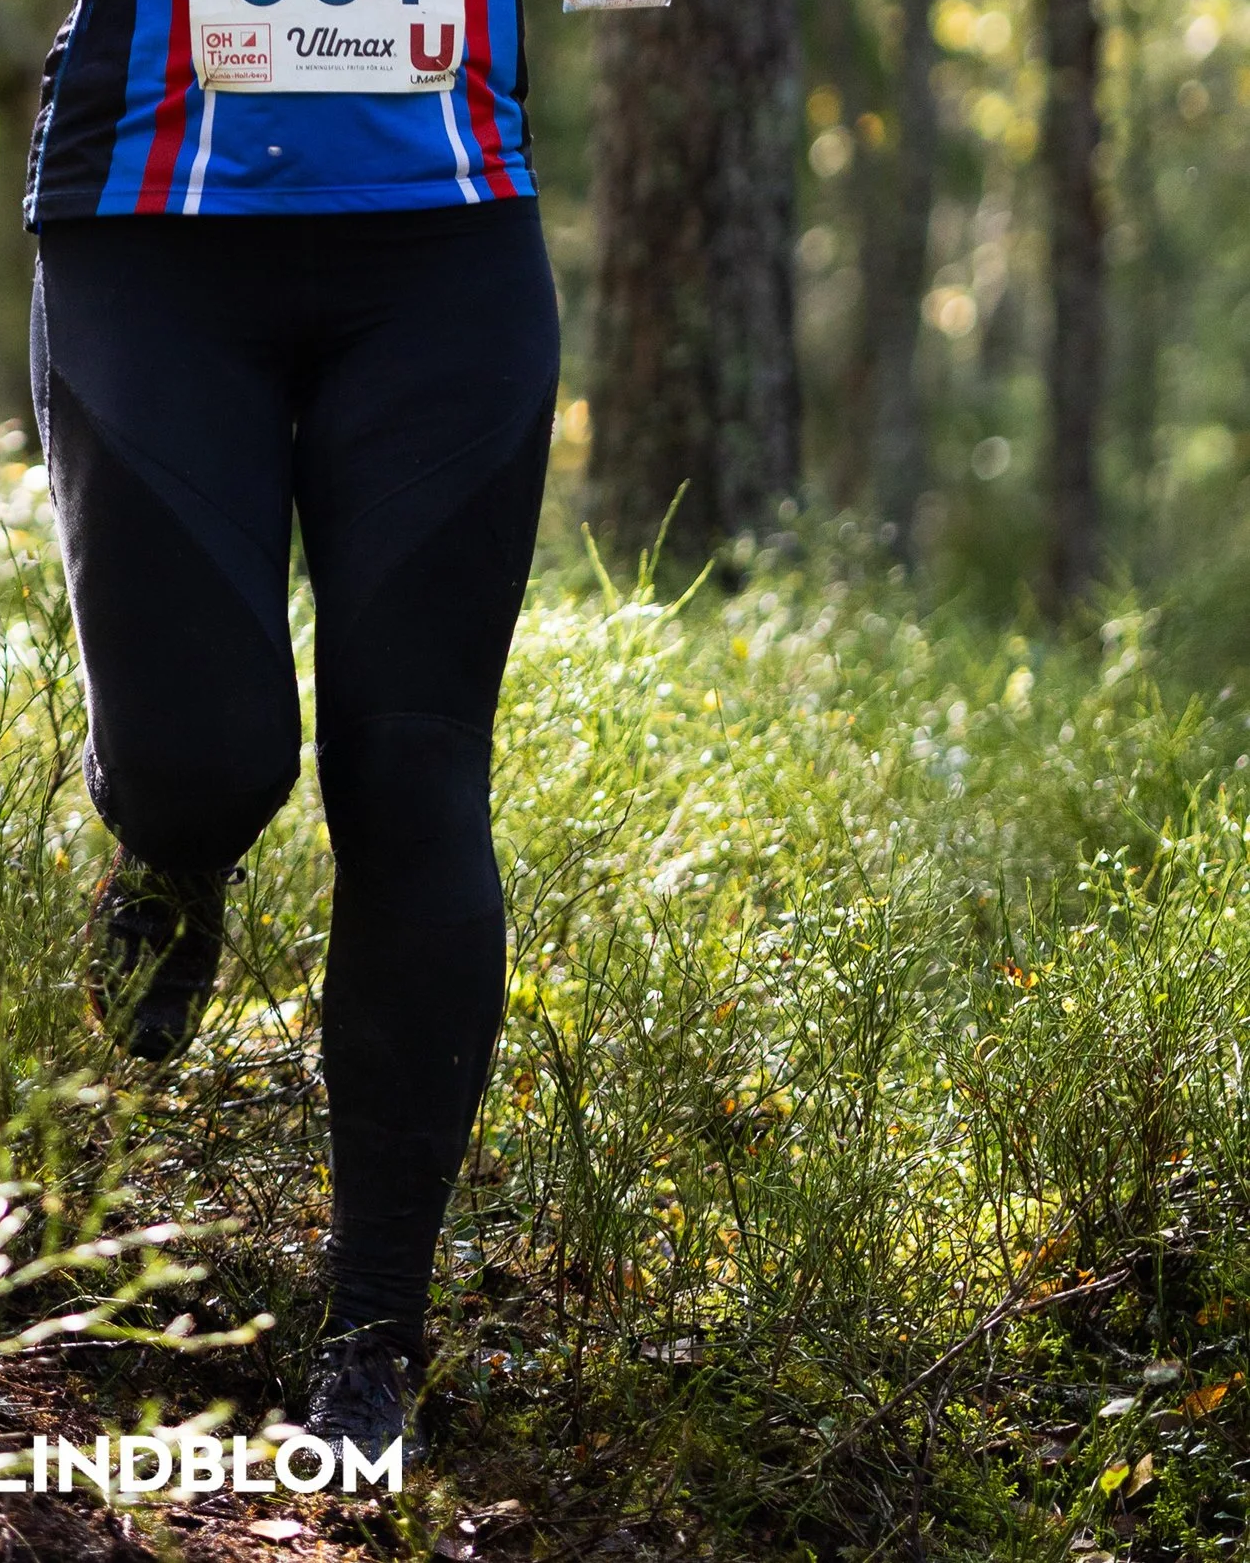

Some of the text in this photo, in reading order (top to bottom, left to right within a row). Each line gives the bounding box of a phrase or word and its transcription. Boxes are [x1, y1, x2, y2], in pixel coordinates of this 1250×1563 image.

[286, 26, 395, 57] Ullmax
[410, 23, 455, 71] U
[207, 50, 268, 65] Tisaren
[410, 74, 446, 84] UMARA
